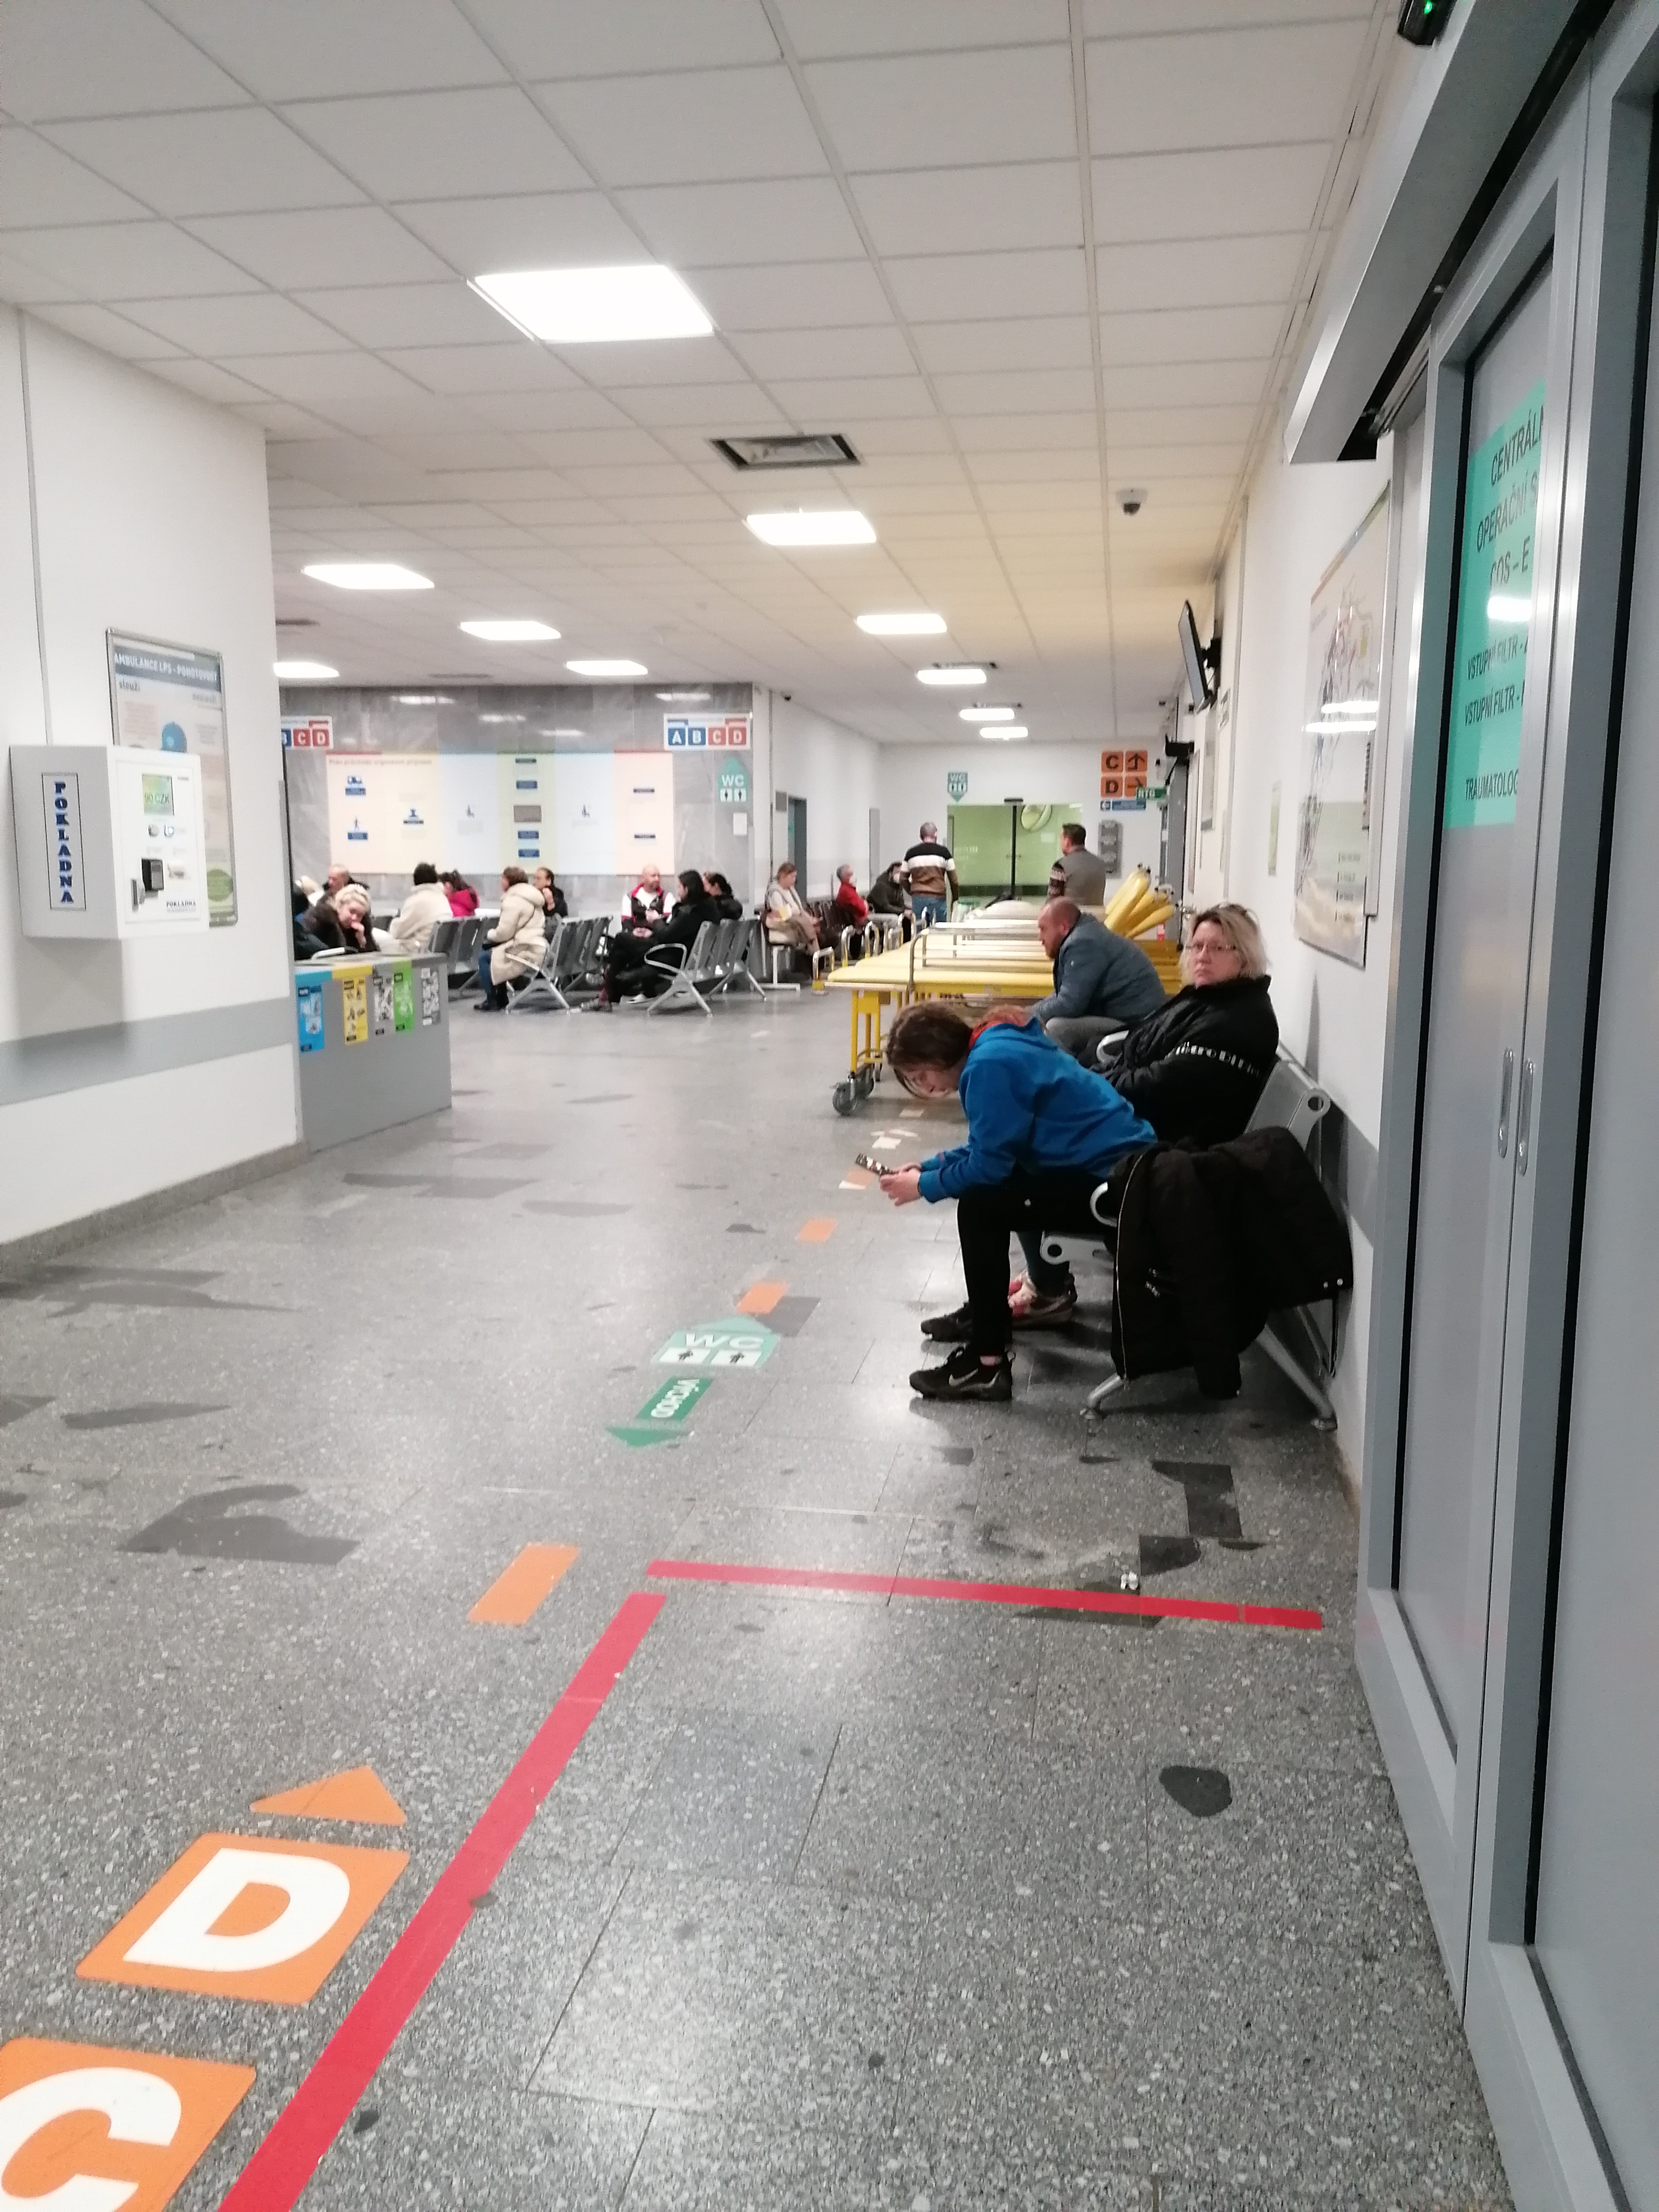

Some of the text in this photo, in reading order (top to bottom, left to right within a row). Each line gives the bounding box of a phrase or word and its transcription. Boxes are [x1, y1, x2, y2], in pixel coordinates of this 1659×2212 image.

[1477, 470, 1528, 553] OPERAČNÍ
[1522, 536, 1530, 572] E
[1468, 640, 1496, 680] VSTUPNÍ
[1497, 634, 1519, 664] FILTR
[1465, 687, 1494, 727] VSTUPNÍ
[1494, 685, 1515, 717] FILTR
[298, 732, 306, 745] C
[317, 731, 326, 745] D
[672, 729, 743, 744] A B C D
[1105, 755, 1119, 769] C
[721, 774, 744, 787] WC
[950, 774, 966, 782] WC
[1105, 780, 1119, 794] D
[54, 781, 74, 904] POKLADNA
[685, 1333, 764, 1349] WC
[123, 1848, 350, 1973] D
[0, 2067, 182, 2212] C
